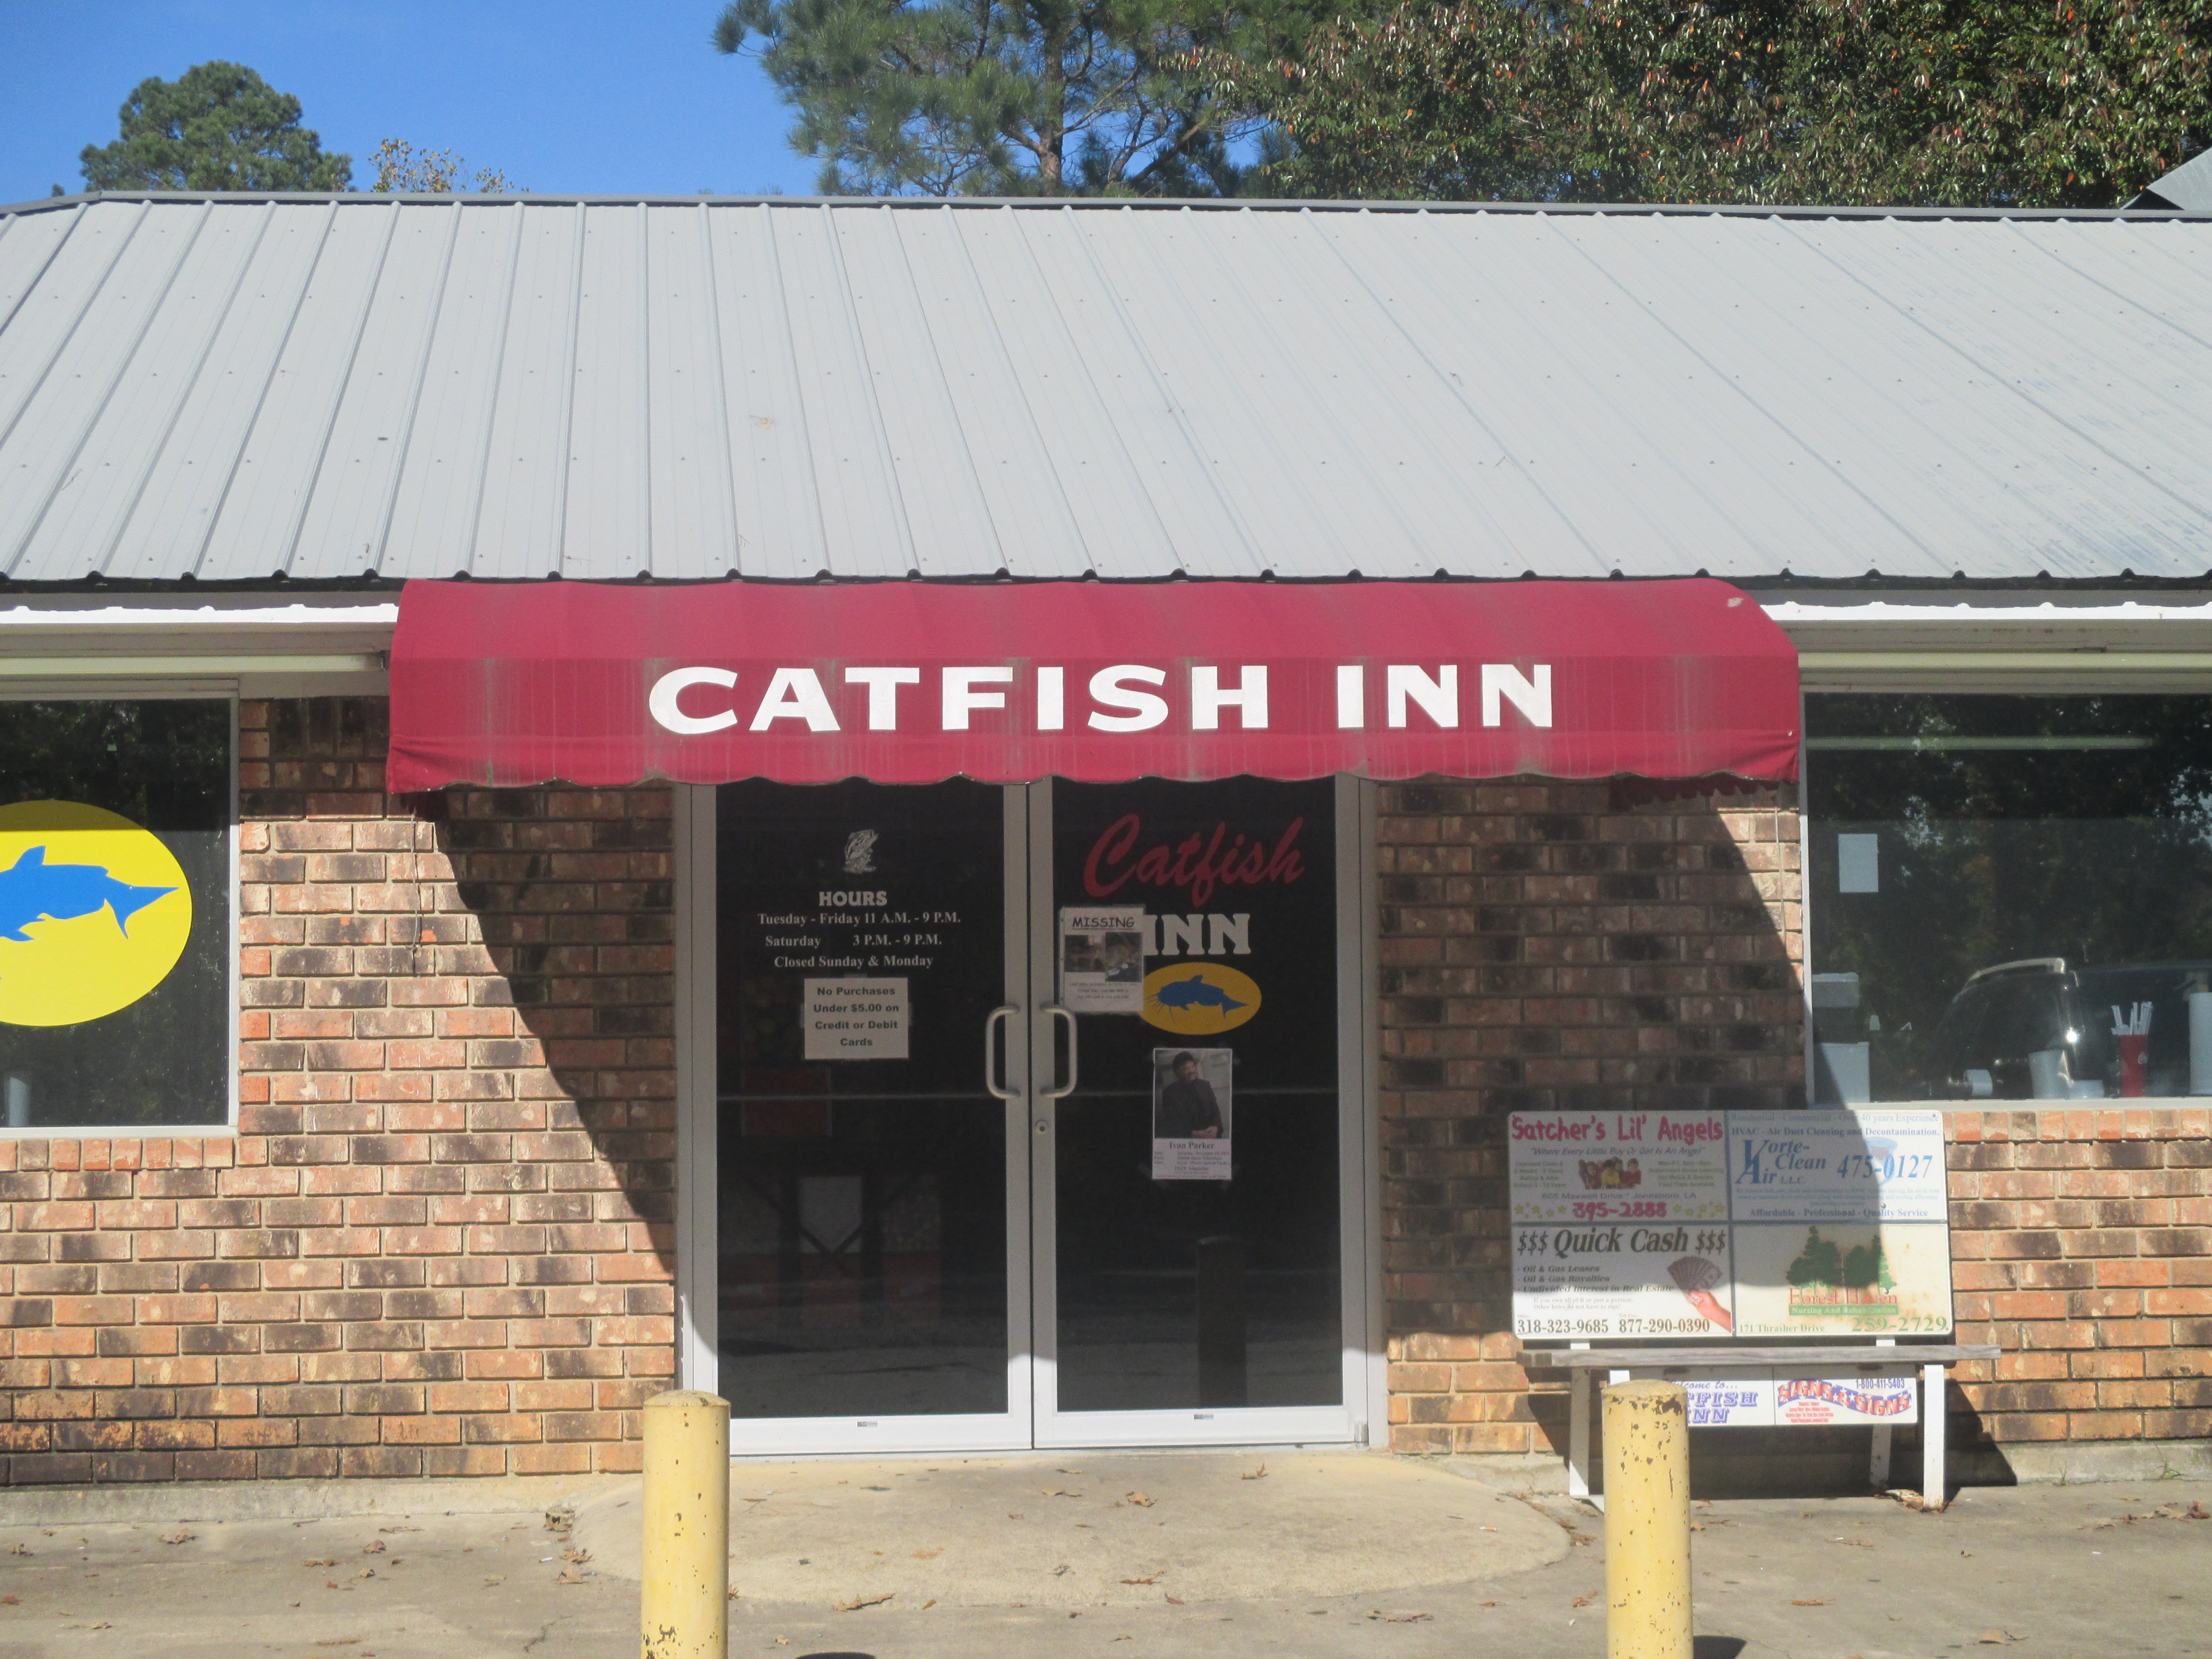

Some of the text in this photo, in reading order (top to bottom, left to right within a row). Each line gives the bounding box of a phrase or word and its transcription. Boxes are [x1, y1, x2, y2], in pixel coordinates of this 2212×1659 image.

[649, 663, 1552, 734] CATFISH INN
[1083, 813, 1305, 907] Catfish
[819, 891, 887, 906] HOURS
[758, 914, 806, 926] Tuesday
[819, 913, 860, 926] Friday
[865, 913, 875, 924] 11
[881, 913, 910, 923] A.M.
[923, 913, 929, 923] 9
[934, 912, 961, 923] P.M.
[1072, 916, 1134, 928] MISSING
[766, 936, 821, 948] Saturday
[853, 935, 860, 945] 3
[865, 935, 891, 945] P.M.
[904, 935, 910, 945] 9
[915, 935, 942, 945] P.M.
[1143, 914, 1251, 955] INN
[774, 956, 933, 968] Closed Sunday & Monday
[837, 987, 895, 995] Purchases
[814, 1004, 848, 1012] Under
[851, 1003, 882, 1013] $5.00
[815, 1021, 849, 1030] Credit
[868, 1020, 898, 1029] Debit
[841, 1038, 873, 1046] Cards
[1896, 1114, 1939, 1122] Experience
[1512, 1115, 1724, 1145] Satcher's Lil' Angels
[1806, 1128, 1844, 1137] Cleaning
[1865, 1128, 1939, 1136] Decontamination.
[1563, 1147, 1584, 1155] Every
[1775, 1154, 1827, 1169] Clean
[1837, 1154, 1933, 1179] 475-0127
[1573, 1202, 1667, 1222] 395-2888
[1752, 1208, 1795, 1216] Affordable
[1803, 1208, 1855, 1216] Professional
[1863, 1208, 1894, 1218] Quality
[1898, 1208, 1928, 1216] Service
[1517, 1227, 1726, 1259] $$$ Quick Cash $$$
[1568, 1275, 1610, 1284] Royalties
[1790, 1287, 1898, 1305] Forest Haven
[1517, 1319, 1710, 1333] 318-323-9685 877-290-0390
[1758, 1324, 1798, 1332] Thrasher
[1801, 1324, 1825, 1332] Drive
[1852, 1317, 1948, 1332] 259-2729
[1856, 1377, 1905, 1389] 1-800-411-5403
[1688, 1392, 1758, 1407] FISH
[1778, 1380, 1912, 1416] SIGNS & SIGNS
